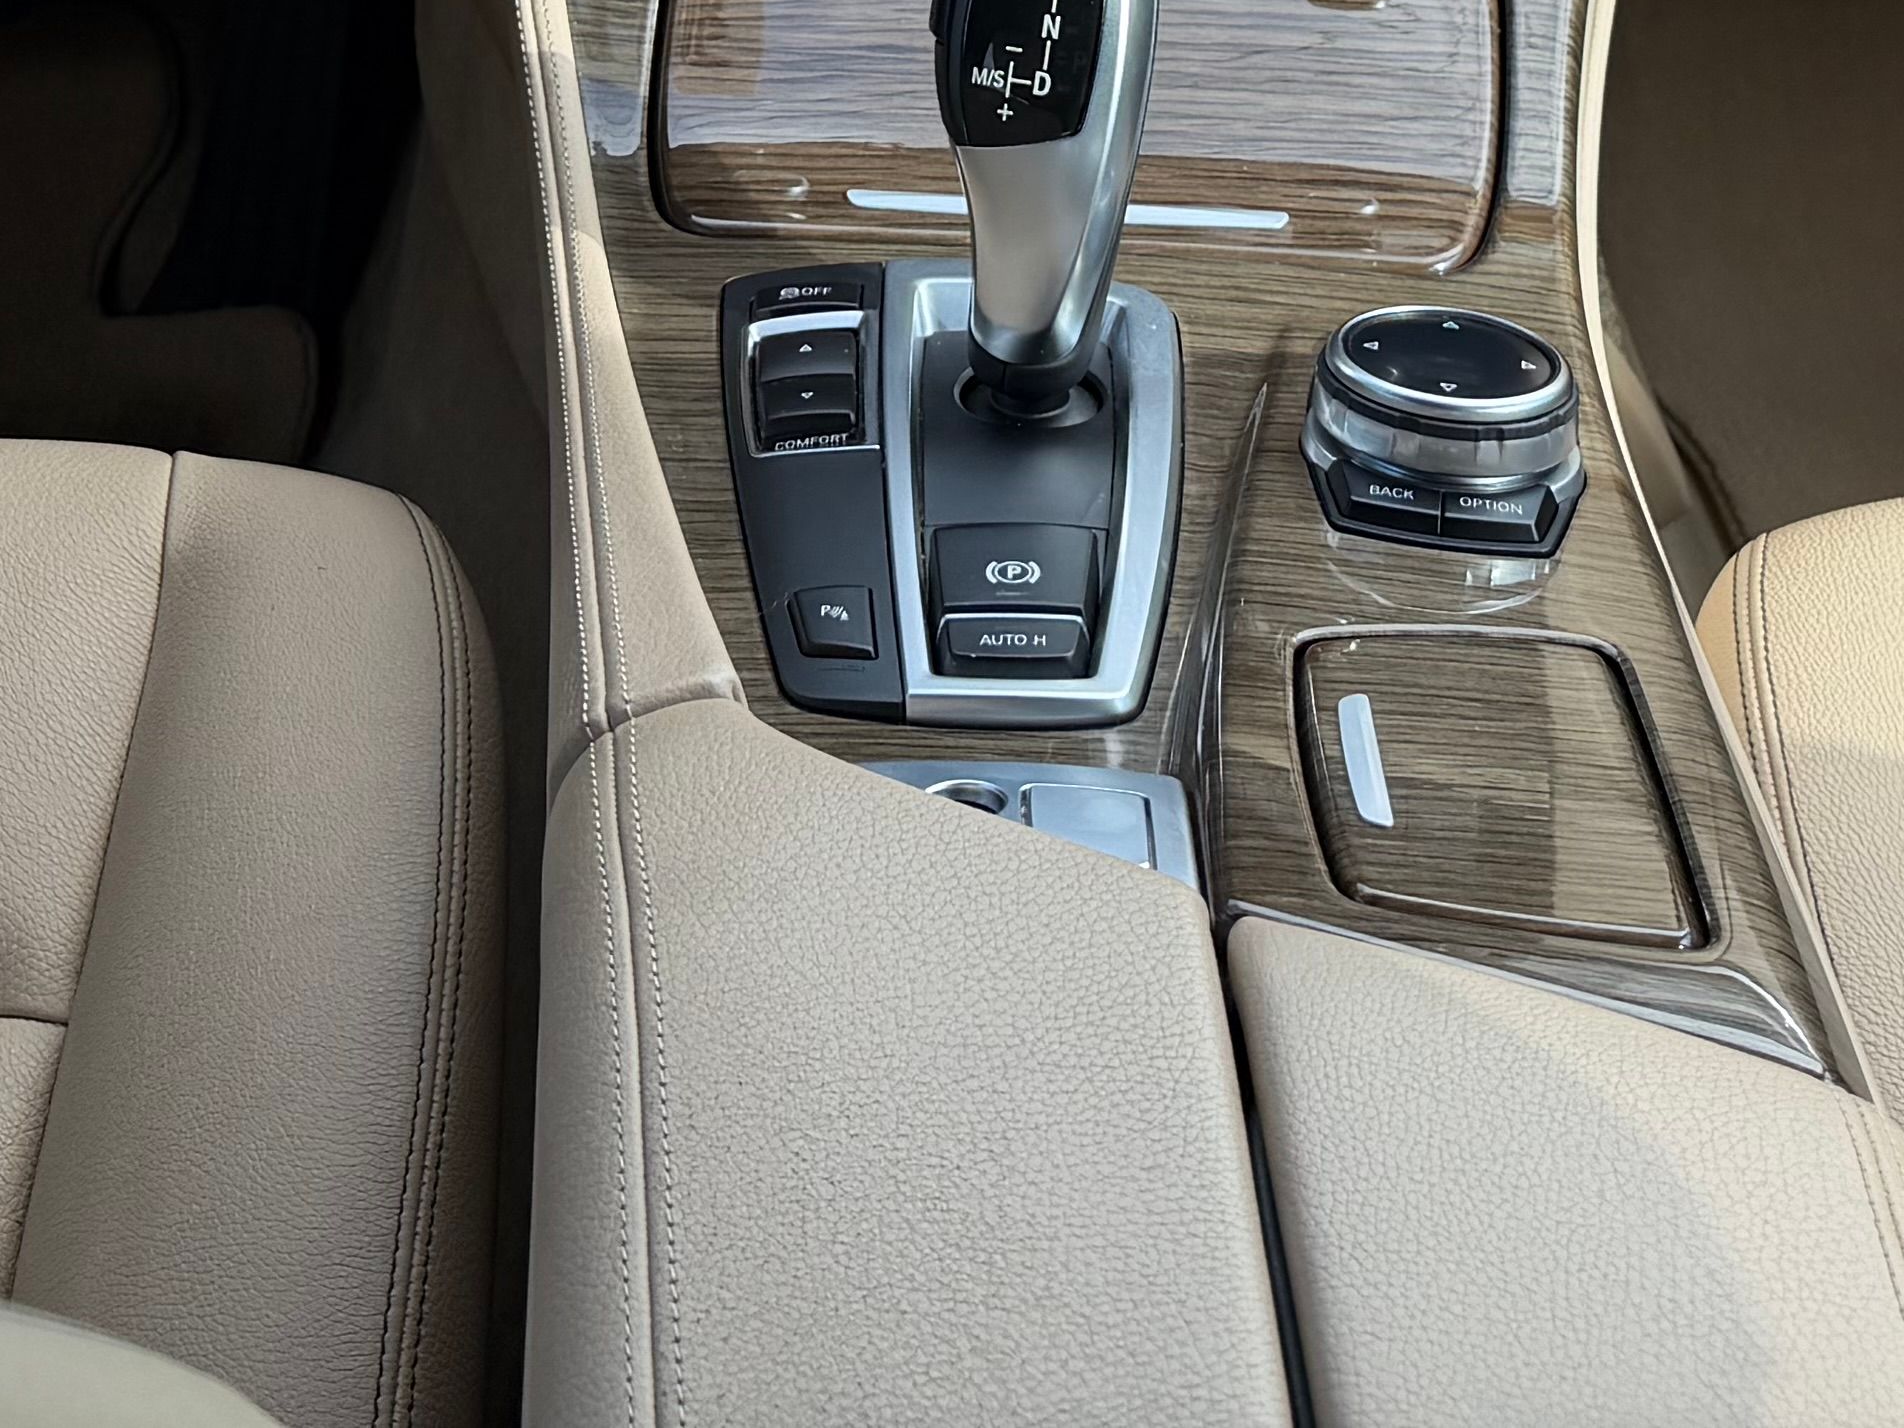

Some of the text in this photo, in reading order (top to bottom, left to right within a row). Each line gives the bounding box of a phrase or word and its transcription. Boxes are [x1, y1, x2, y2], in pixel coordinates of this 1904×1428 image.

[1041, 12, 1062, 41] N
[971, 65, 1052, 97] M/S D
[801, 286, 833, 297] OFF
[774, 432, 850, 452] COMFORT
[1369, 483, 1415, 502] BACK
[1459, 495, 1524, 517] OPTION
[979, 631, 1047, 647] AUTO H
